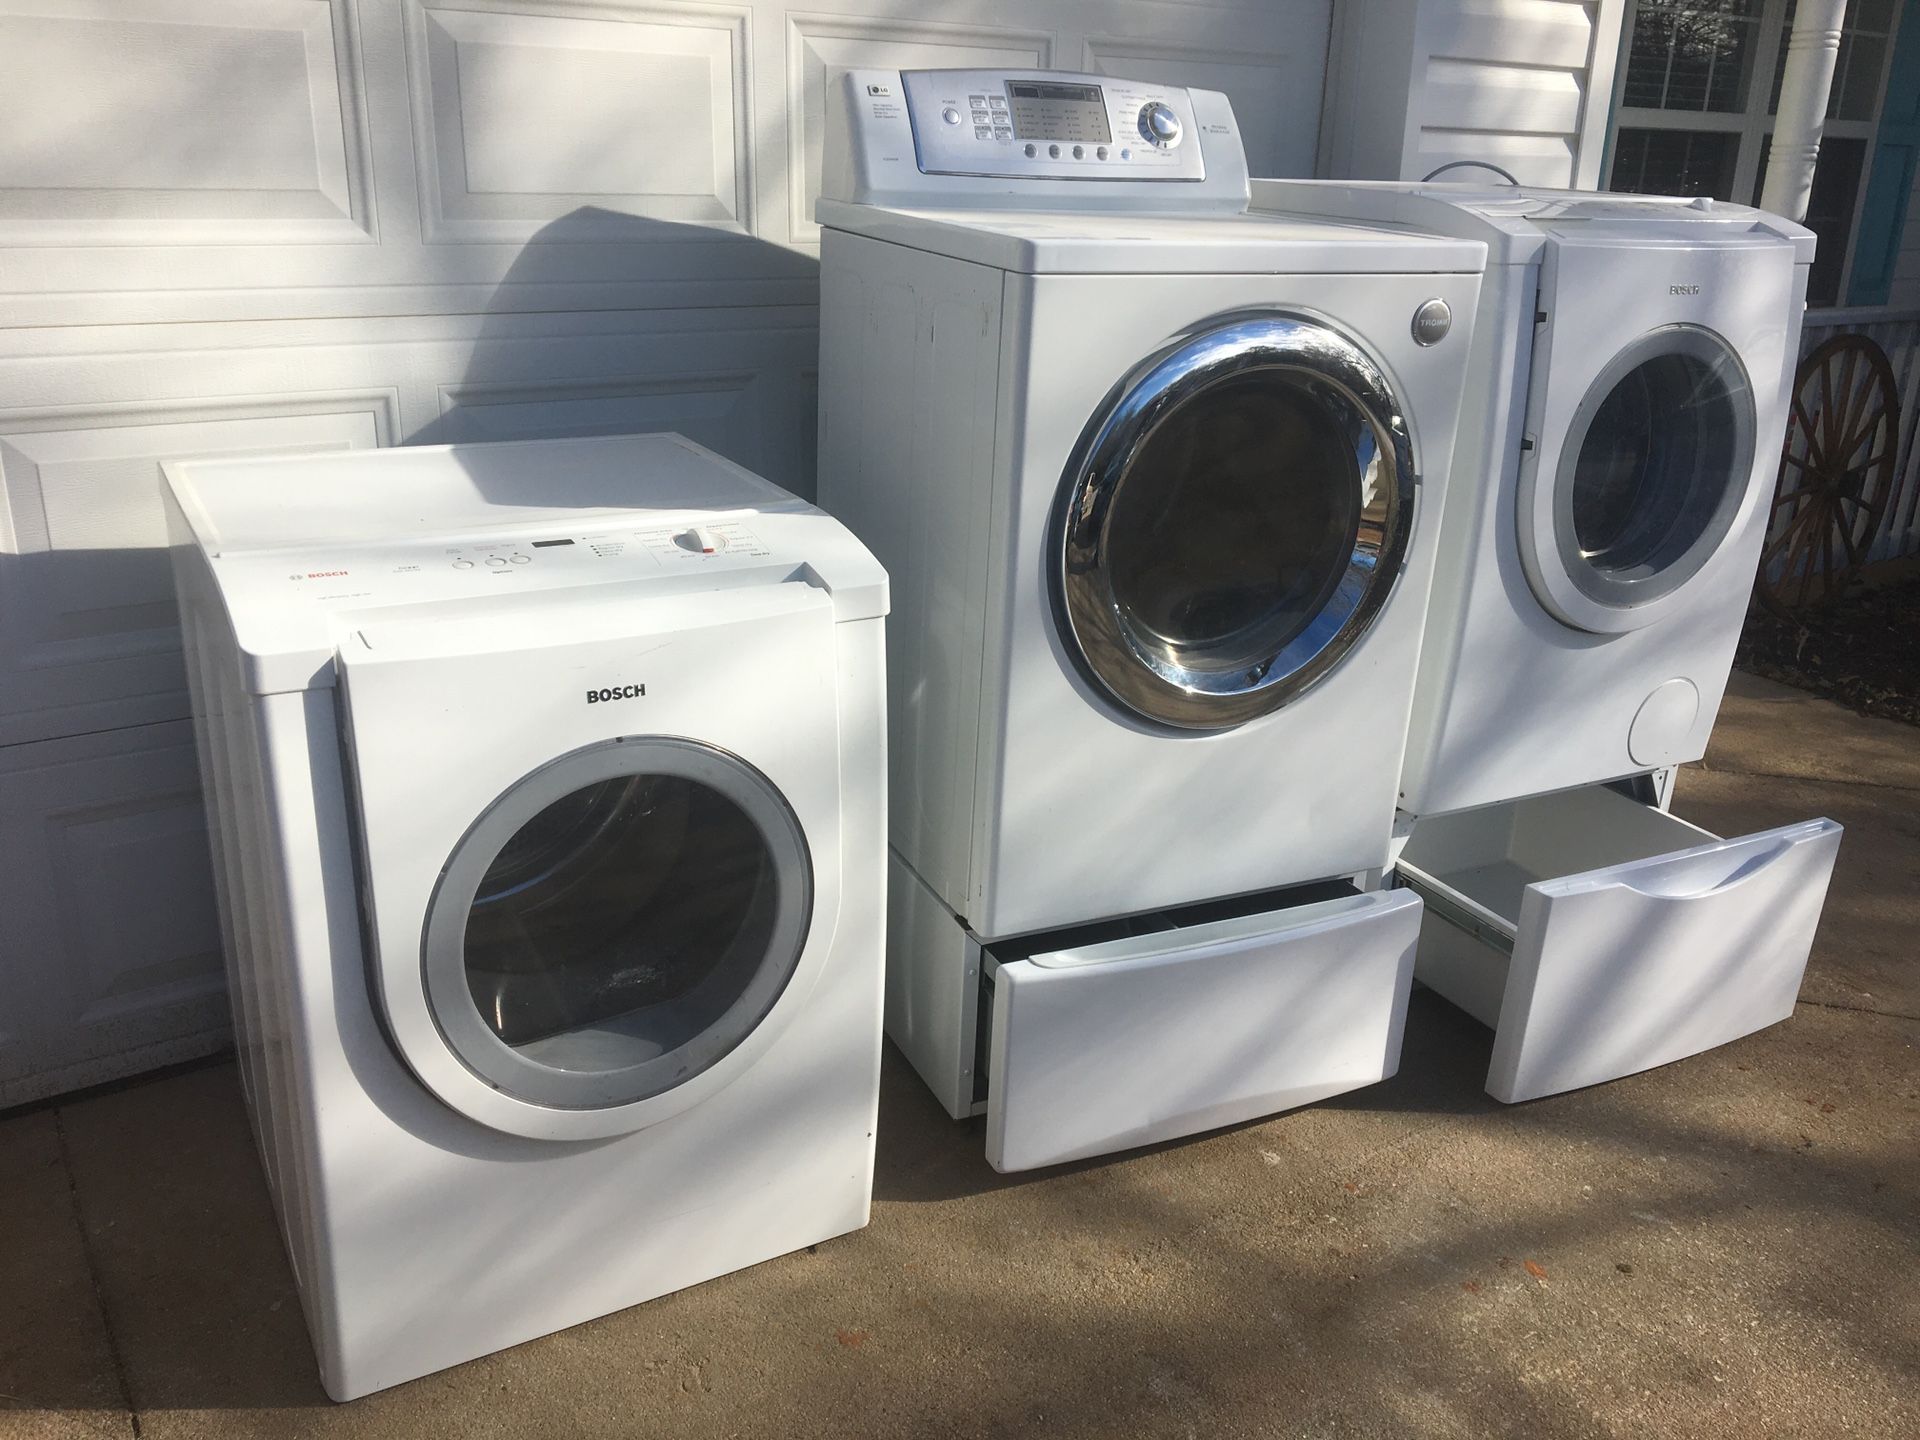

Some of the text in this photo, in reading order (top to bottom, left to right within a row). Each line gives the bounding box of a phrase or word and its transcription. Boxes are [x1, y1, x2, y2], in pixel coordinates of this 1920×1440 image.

[1669, 284, 1699, 295] BOSCH
[307, 571, 349, 579] BOSCH
[586, 684, 646, 704] BOSCH
